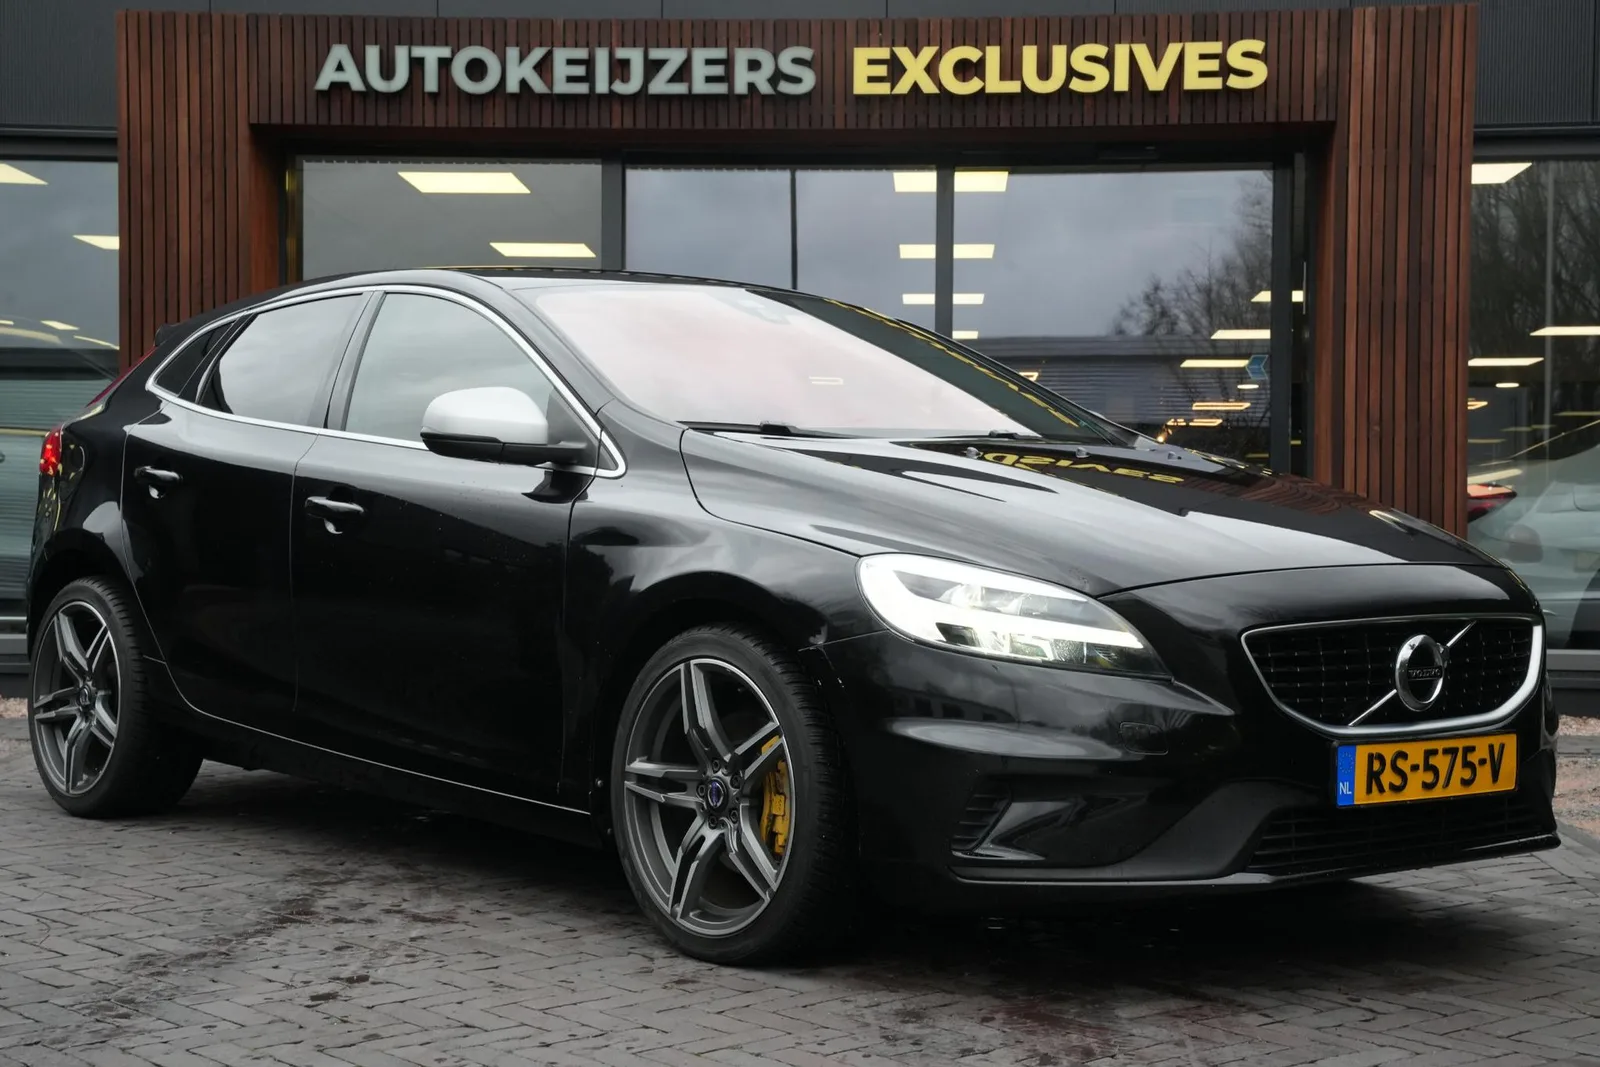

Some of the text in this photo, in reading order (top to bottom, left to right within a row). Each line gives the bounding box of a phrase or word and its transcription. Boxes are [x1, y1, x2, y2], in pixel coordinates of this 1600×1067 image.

[314, 39, 1269, 95] AUTOKEIJZERS EXCLUSIVES
[1339, 781, 1352, 795] NL
[1365, 742, 1506, 796] RS-575-V
